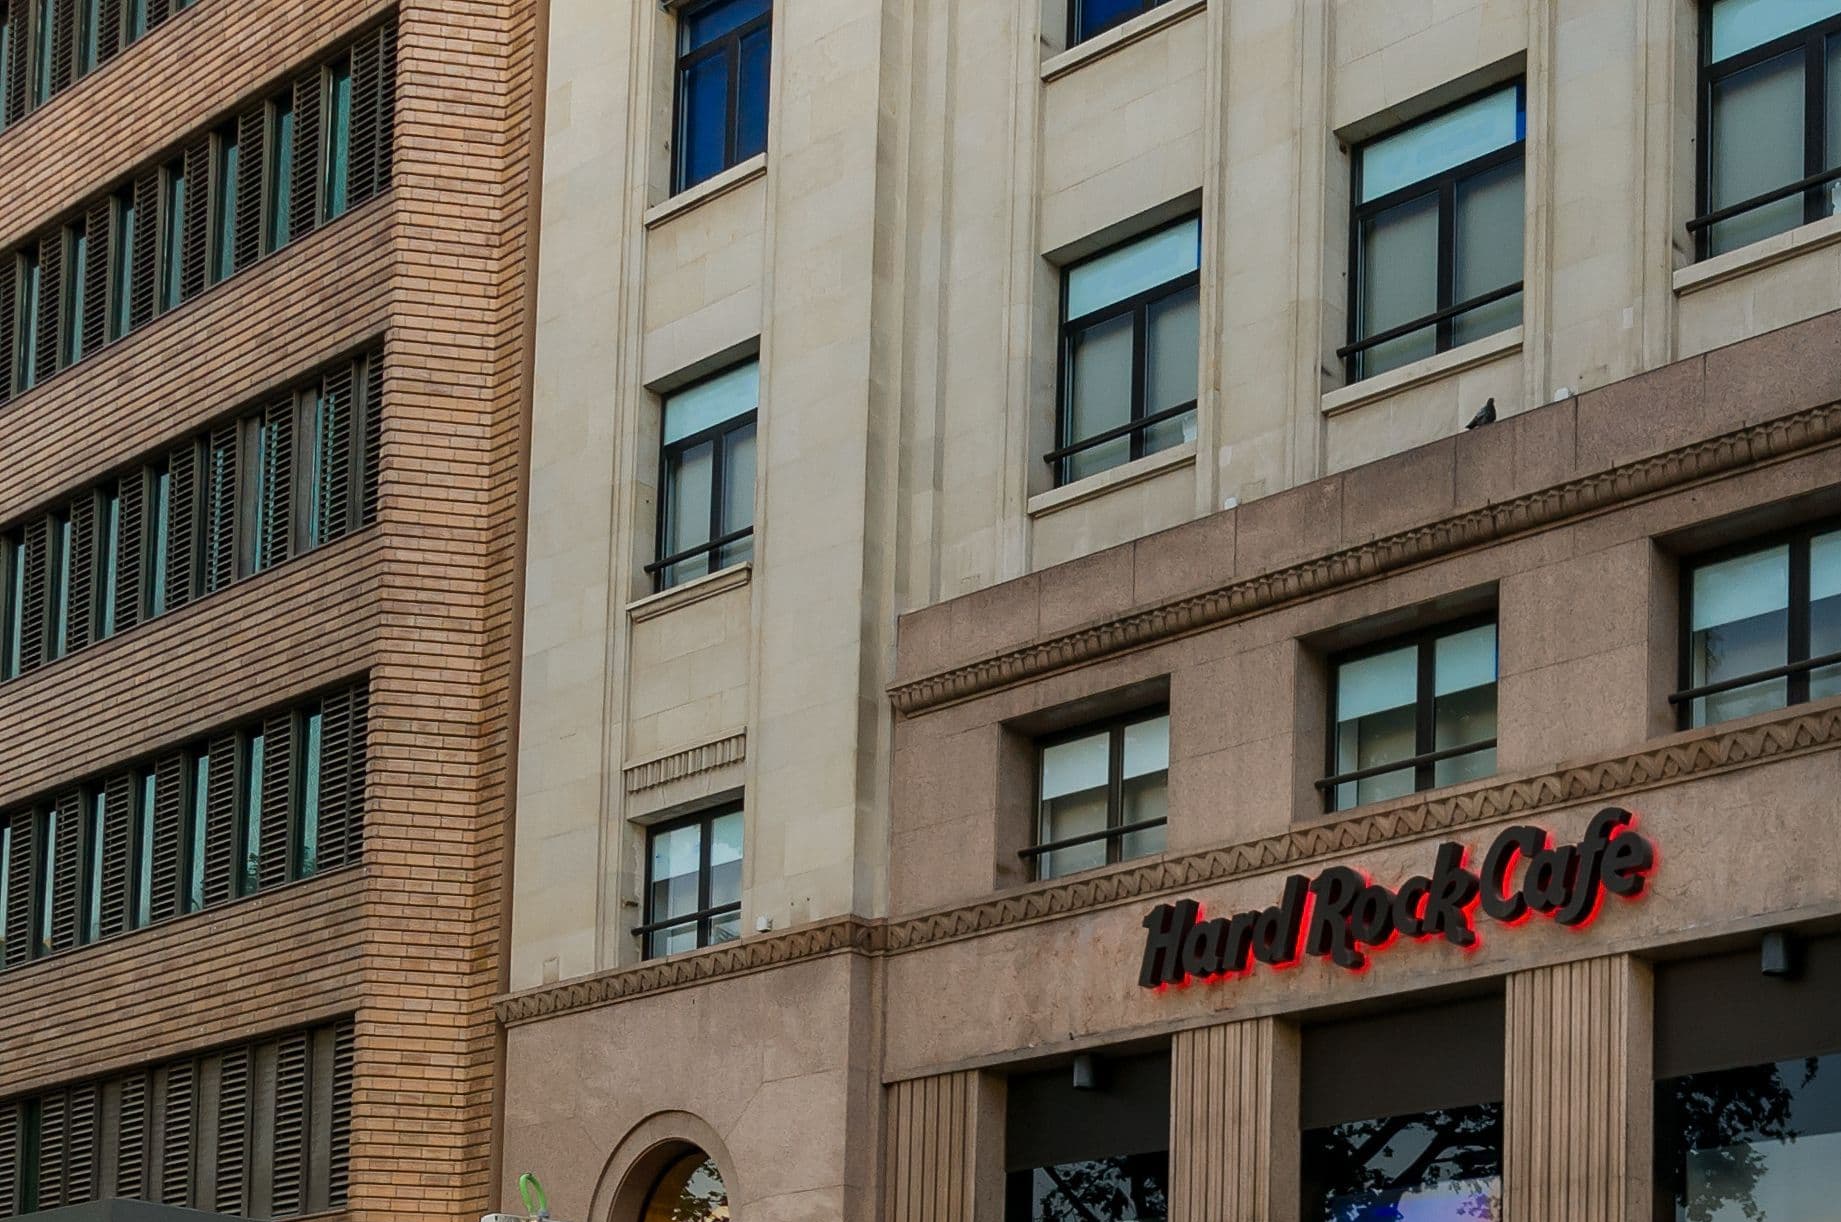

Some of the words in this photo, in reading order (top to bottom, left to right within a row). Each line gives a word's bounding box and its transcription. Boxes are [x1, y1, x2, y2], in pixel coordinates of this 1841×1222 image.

[1139, 874, 1310, 988] Hard
[1306, 841, 1480, 968] Rock
[1480, 807, 1653, 926] Cafe
